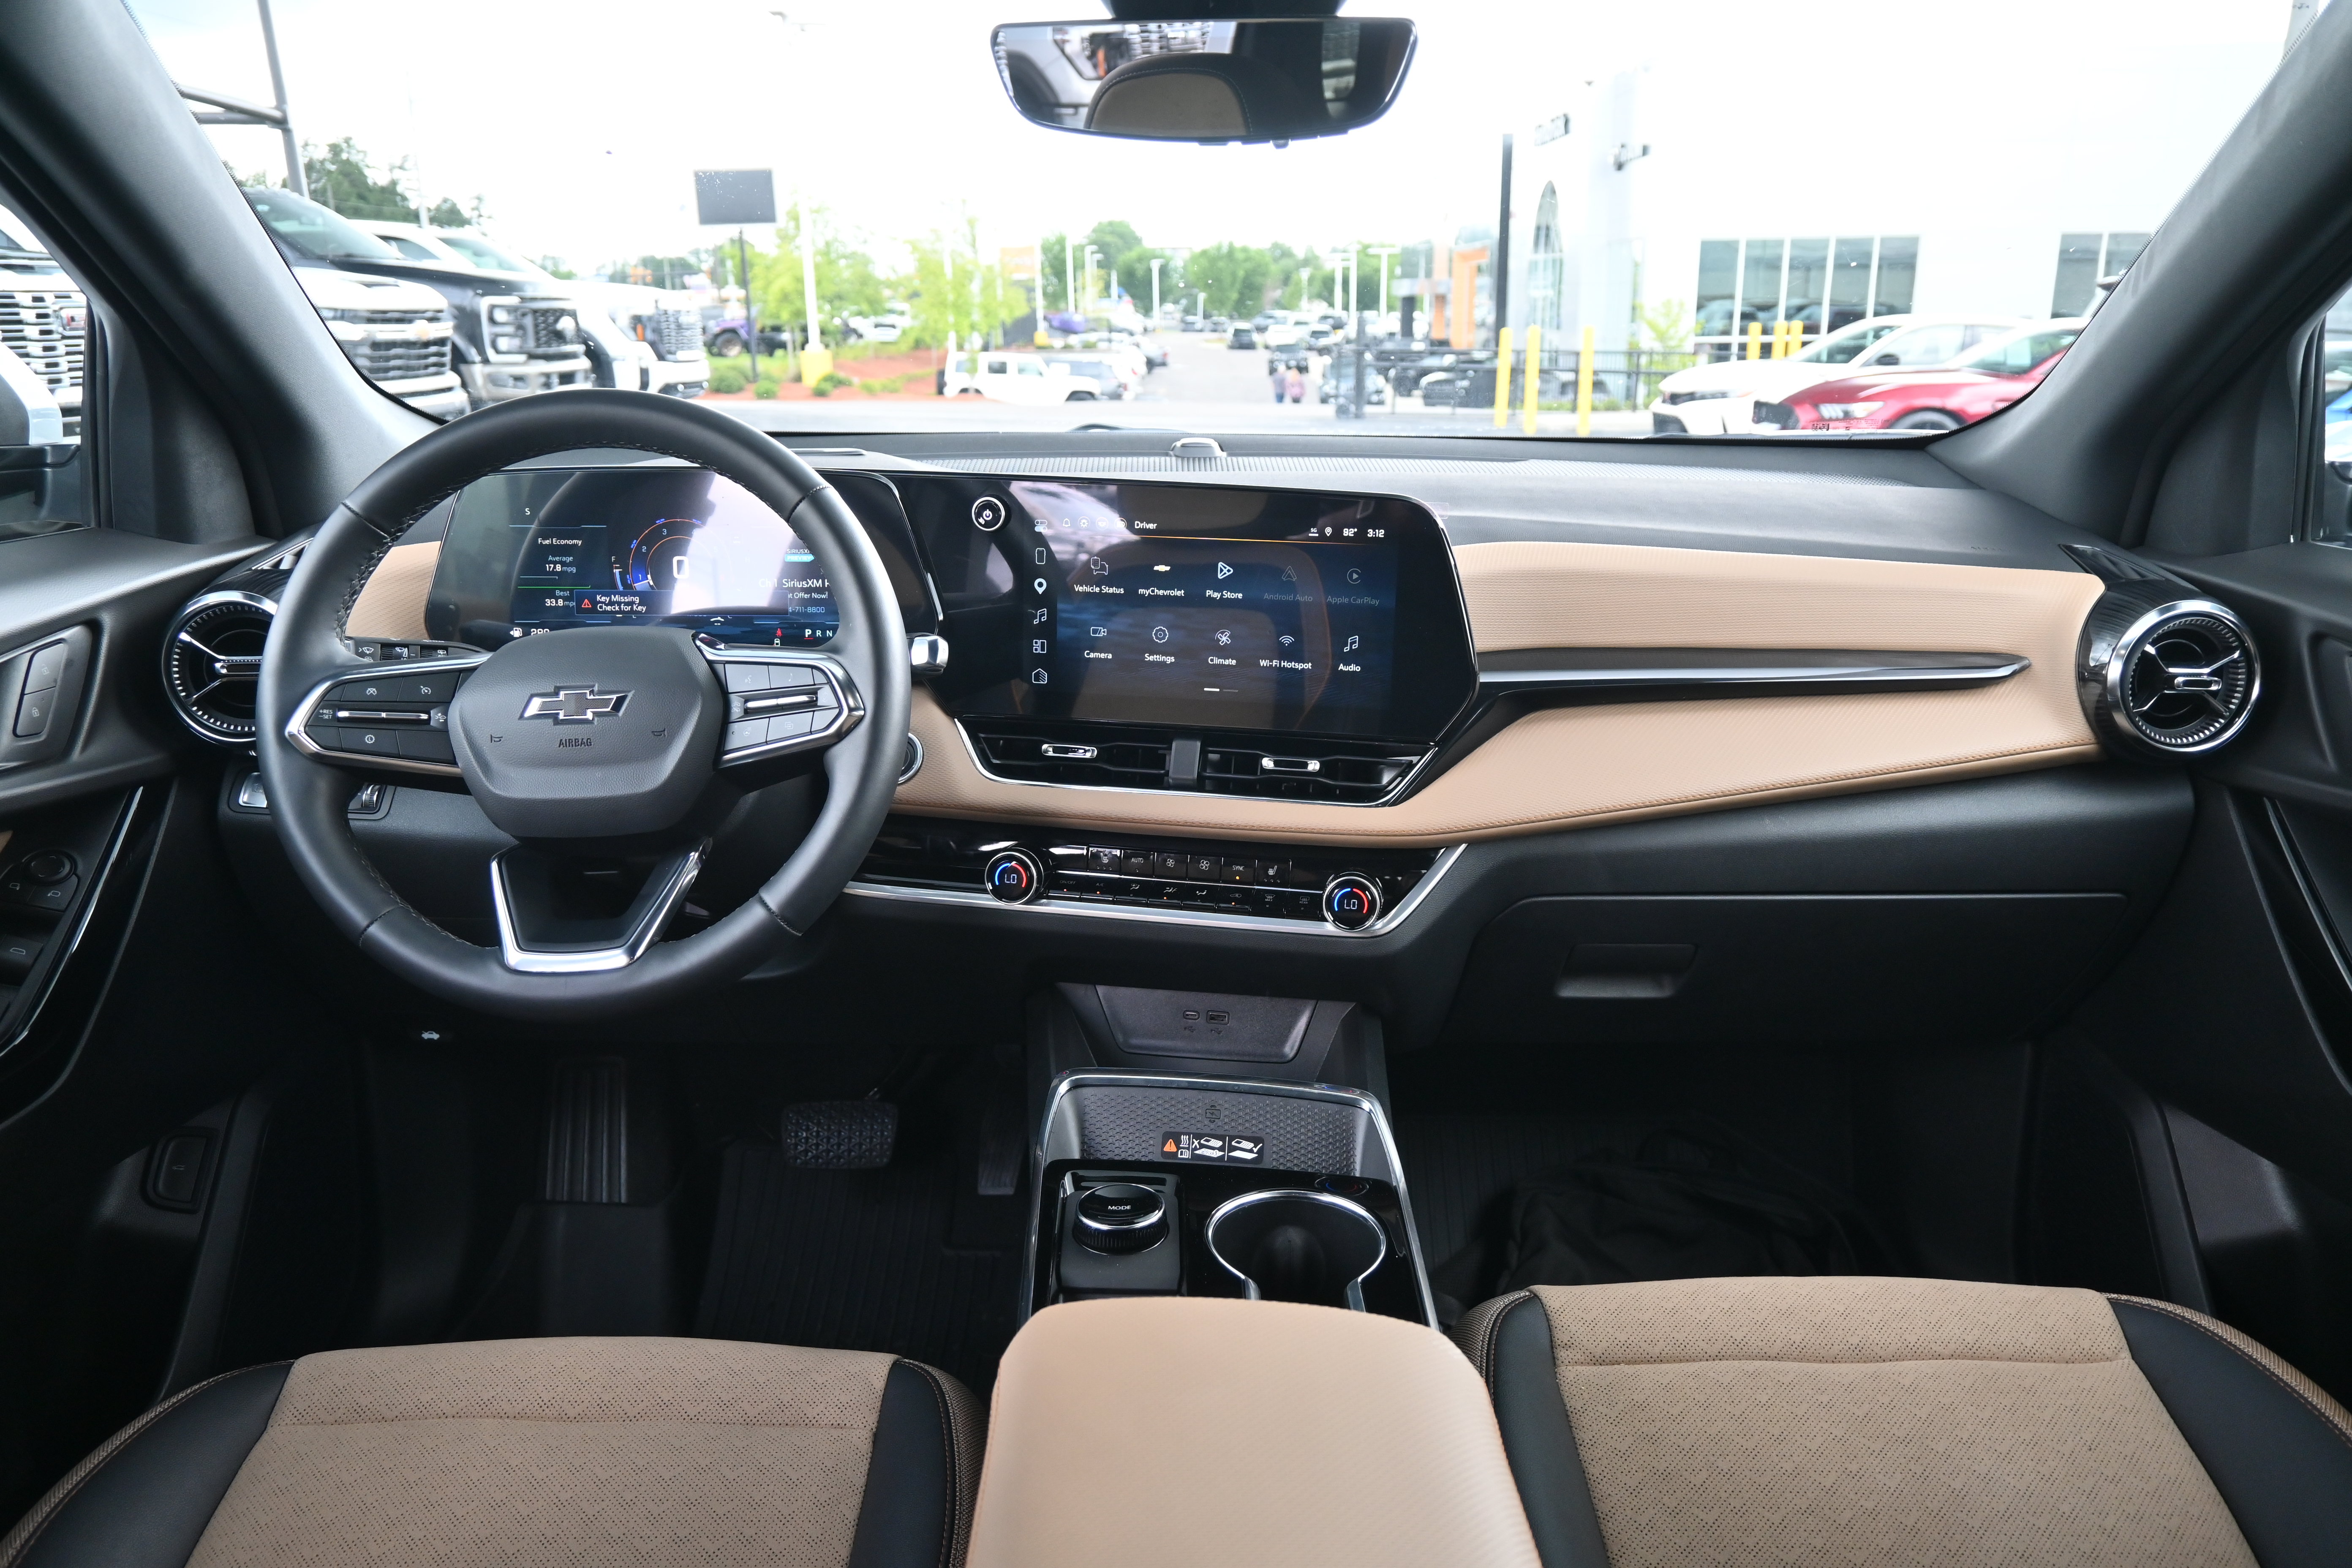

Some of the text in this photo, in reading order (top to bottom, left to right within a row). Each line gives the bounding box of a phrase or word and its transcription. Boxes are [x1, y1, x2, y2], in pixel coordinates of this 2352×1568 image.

[1135, 521, 1157, 529] Driver
[1343, 528, 1357, 536] 92°
[1367, 529, 1385, 537] 3:12
[672, 555, 689, 579] 0
[759, 579, 771, 587] Ch
[774, 579, 777, 587] 1
[782, 579, 822, 588] SiriusXM
[1074, 584, 1124, 593] Vehicle Status
[1138, 587, 1184, 596] myChevrolet
[597, 595, 639, 603] Key Missing
[1206, 590, 1221, 599] Play
[1327, 596, 1380, 606] Apple CarPlay
[633, 604, 646, 612] Key
[805, 629, 811, 637] P
[1084, 651, 1112, 659] Camera
[1144, 653, 1175, 663] Settings
[1208, 657, 1236, 665] Climate
[1260, 659, 1312, 670] Wi-Fi Hotspot
[1338, 663, 1361, 671] Audio
[558, 738, 592, 748] AIRBAG
[1005, 874, 1017, 884] LO
[1344, 899, 1357, 909] LO
